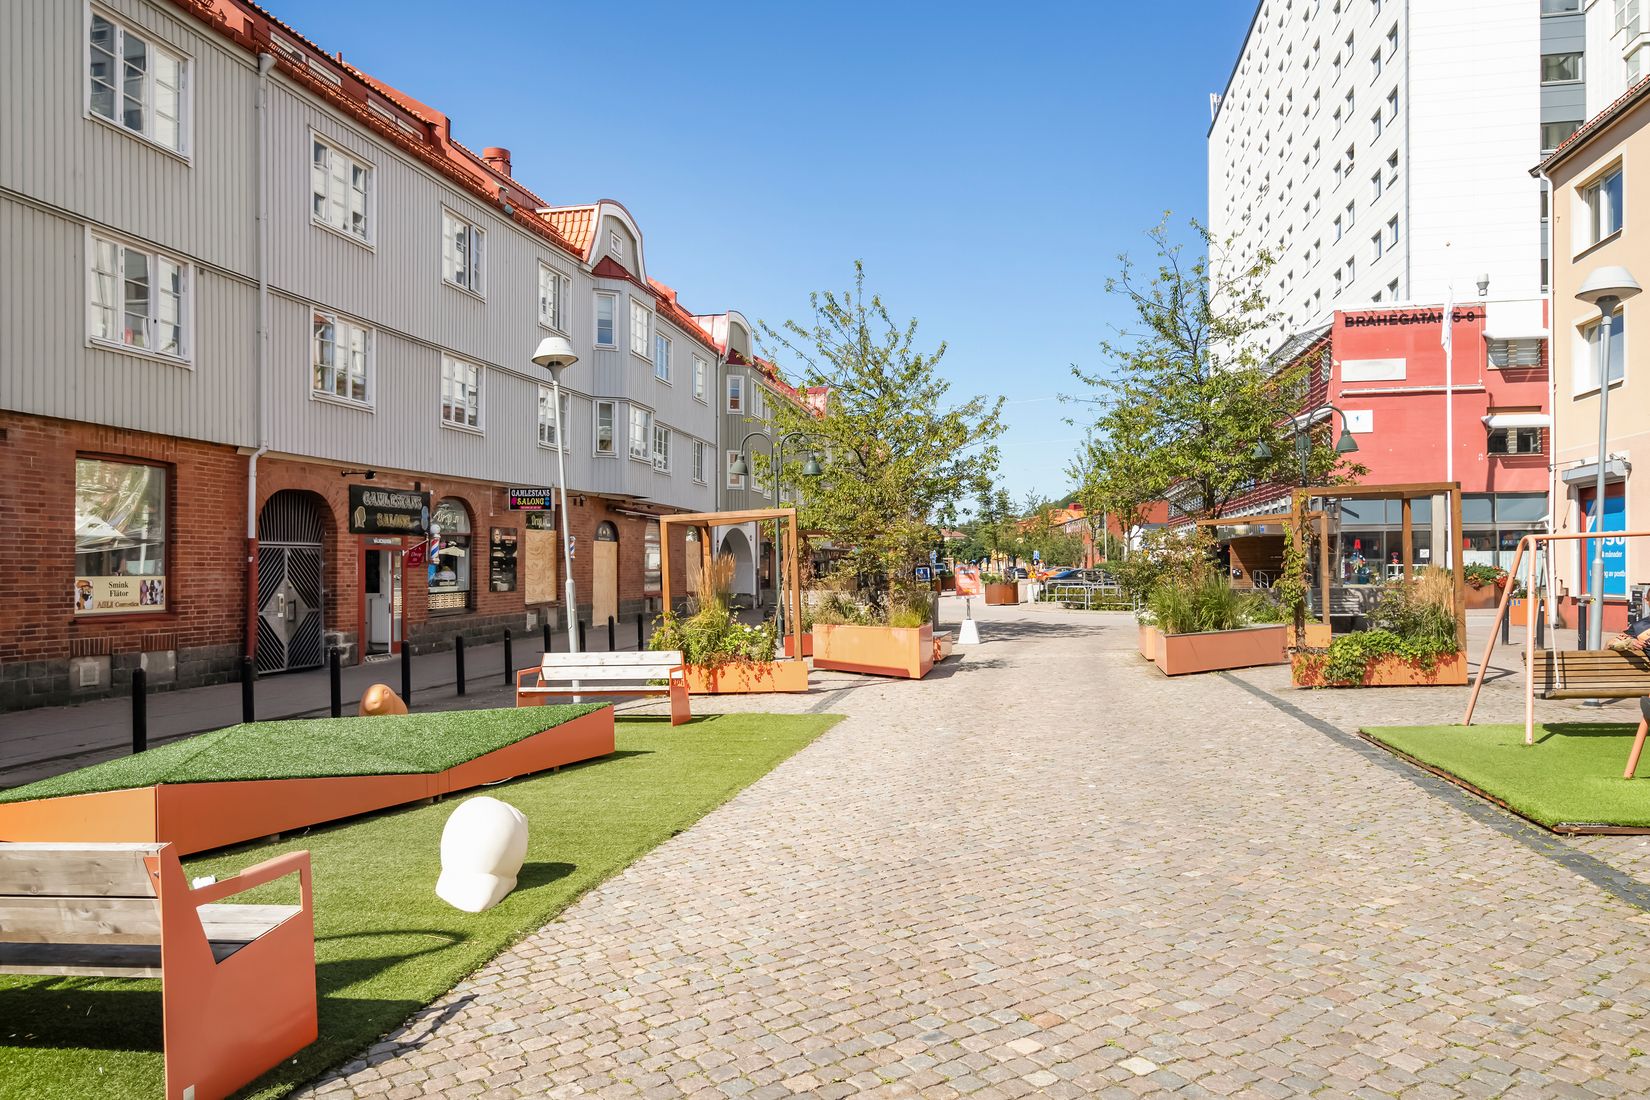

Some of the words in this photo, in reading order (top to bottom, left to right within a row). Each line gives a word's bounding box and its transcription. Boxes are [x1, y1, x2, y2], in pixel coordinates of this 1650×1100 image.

[511, 489, 550, 497] GAMLESTANS
[517, 497, 545, 506] SALONG
[108, 581, 129, 589] Smink
